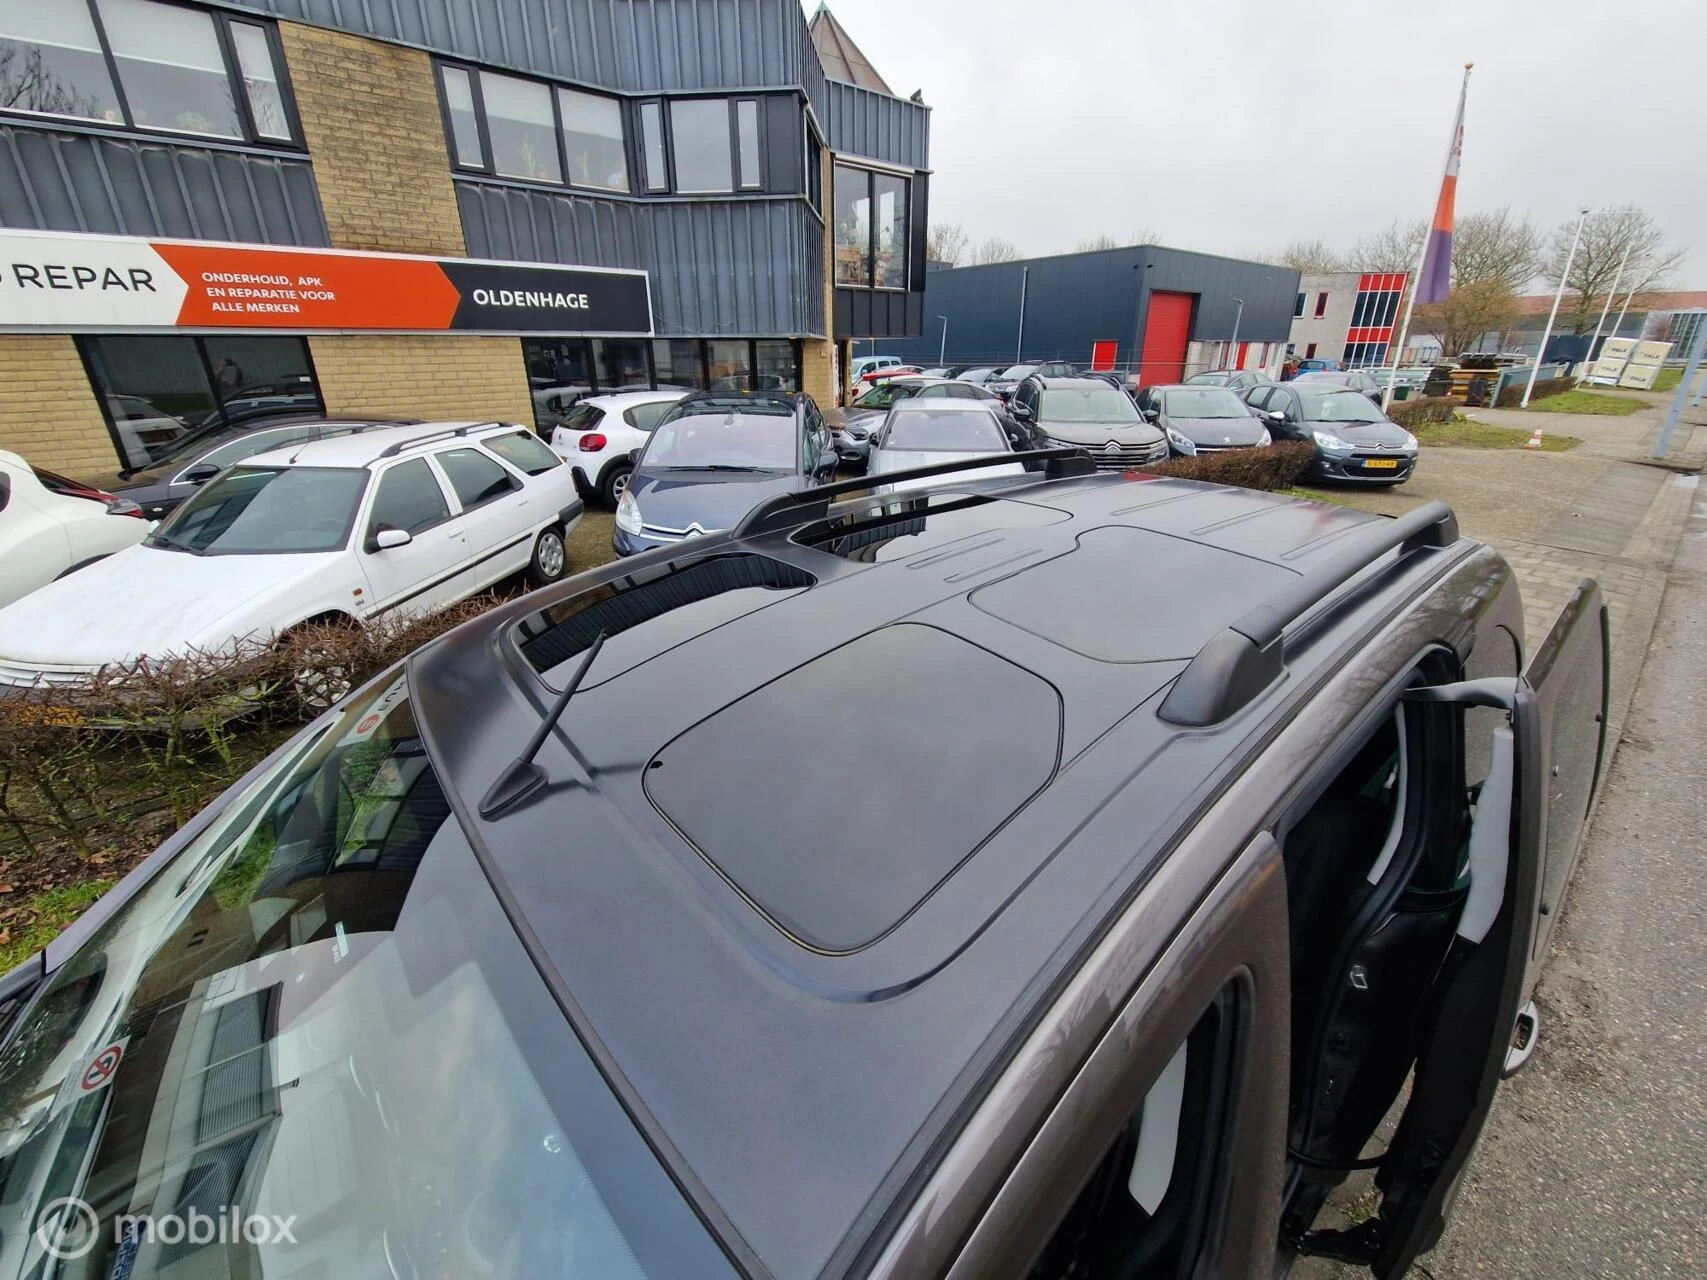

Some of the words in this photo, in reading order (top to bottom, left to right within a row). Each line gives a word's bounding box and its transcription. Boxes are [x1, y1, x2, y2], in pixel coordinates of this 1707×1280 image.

[12, 264, 156, 292] REPAR
[202, 272, 293, 287] ONDERHOUD,
[298, 276, 322, 287] APK
[206, 287, 226, 297] EN
[228, 288, 297, 299] REPARATIE
[299, 290, 335, 301] VOOR
[473, 289, 589, 309] OLDENHAGE
[212, 301, 244, 312] ALLE
[246, 303, 300, 313] MERKEN
